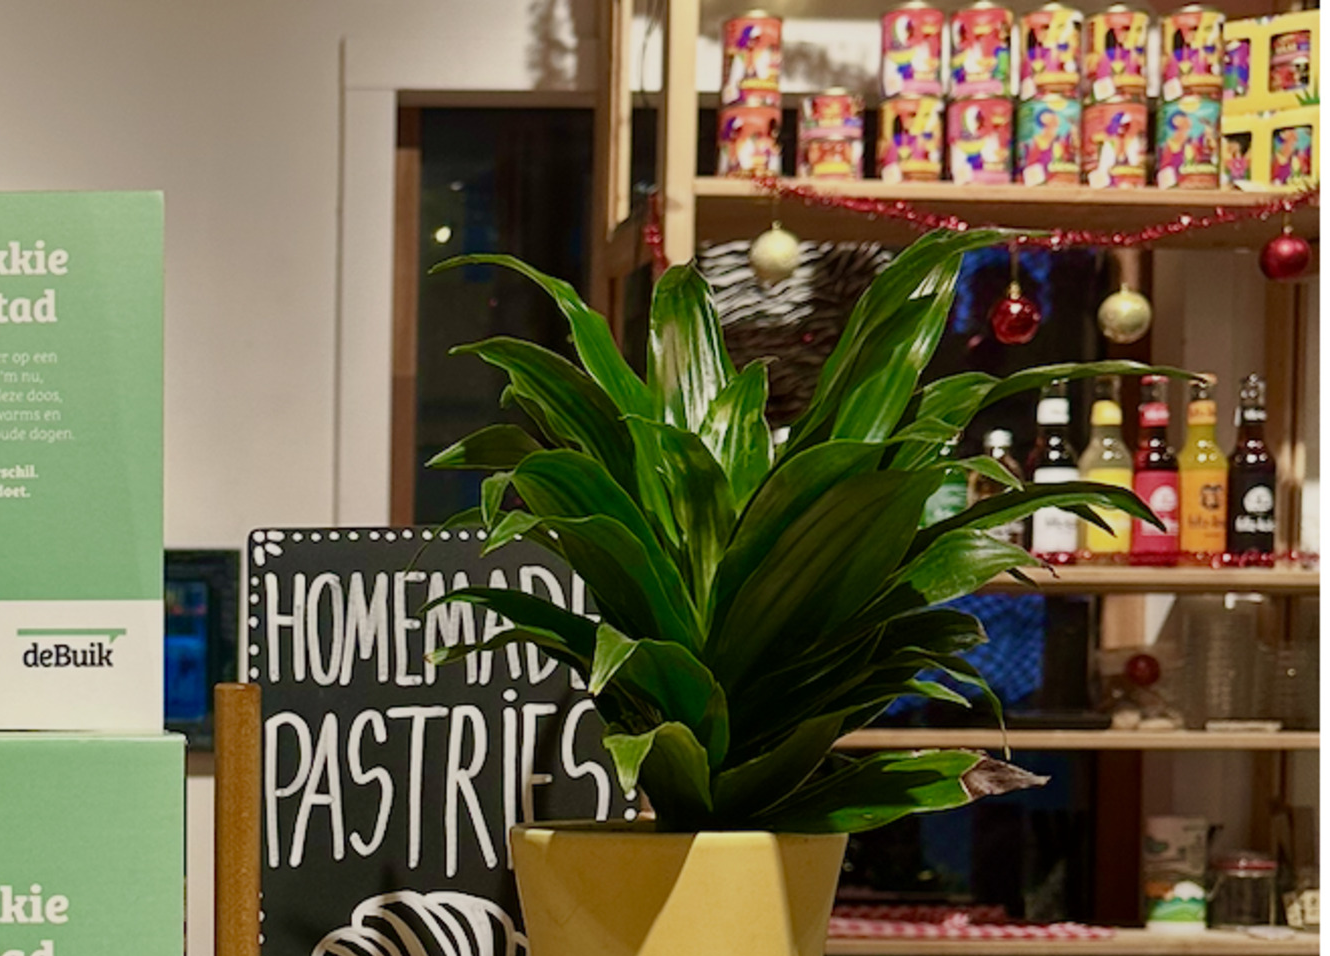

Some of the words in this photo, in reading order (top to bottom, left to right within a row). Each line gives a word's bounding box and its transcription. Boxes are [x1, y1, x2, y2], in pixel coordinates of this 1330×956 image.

[12, 352, 30, 367] op
[33, 352, 58, 365] een
[22, 372, 44, 387] nu,
[26, 389, 63, 405] doos,
[44, 410, 62, 423] en
[29, 427, 75, 446] dagen.
[22, 641, 113, 668] deBuik
